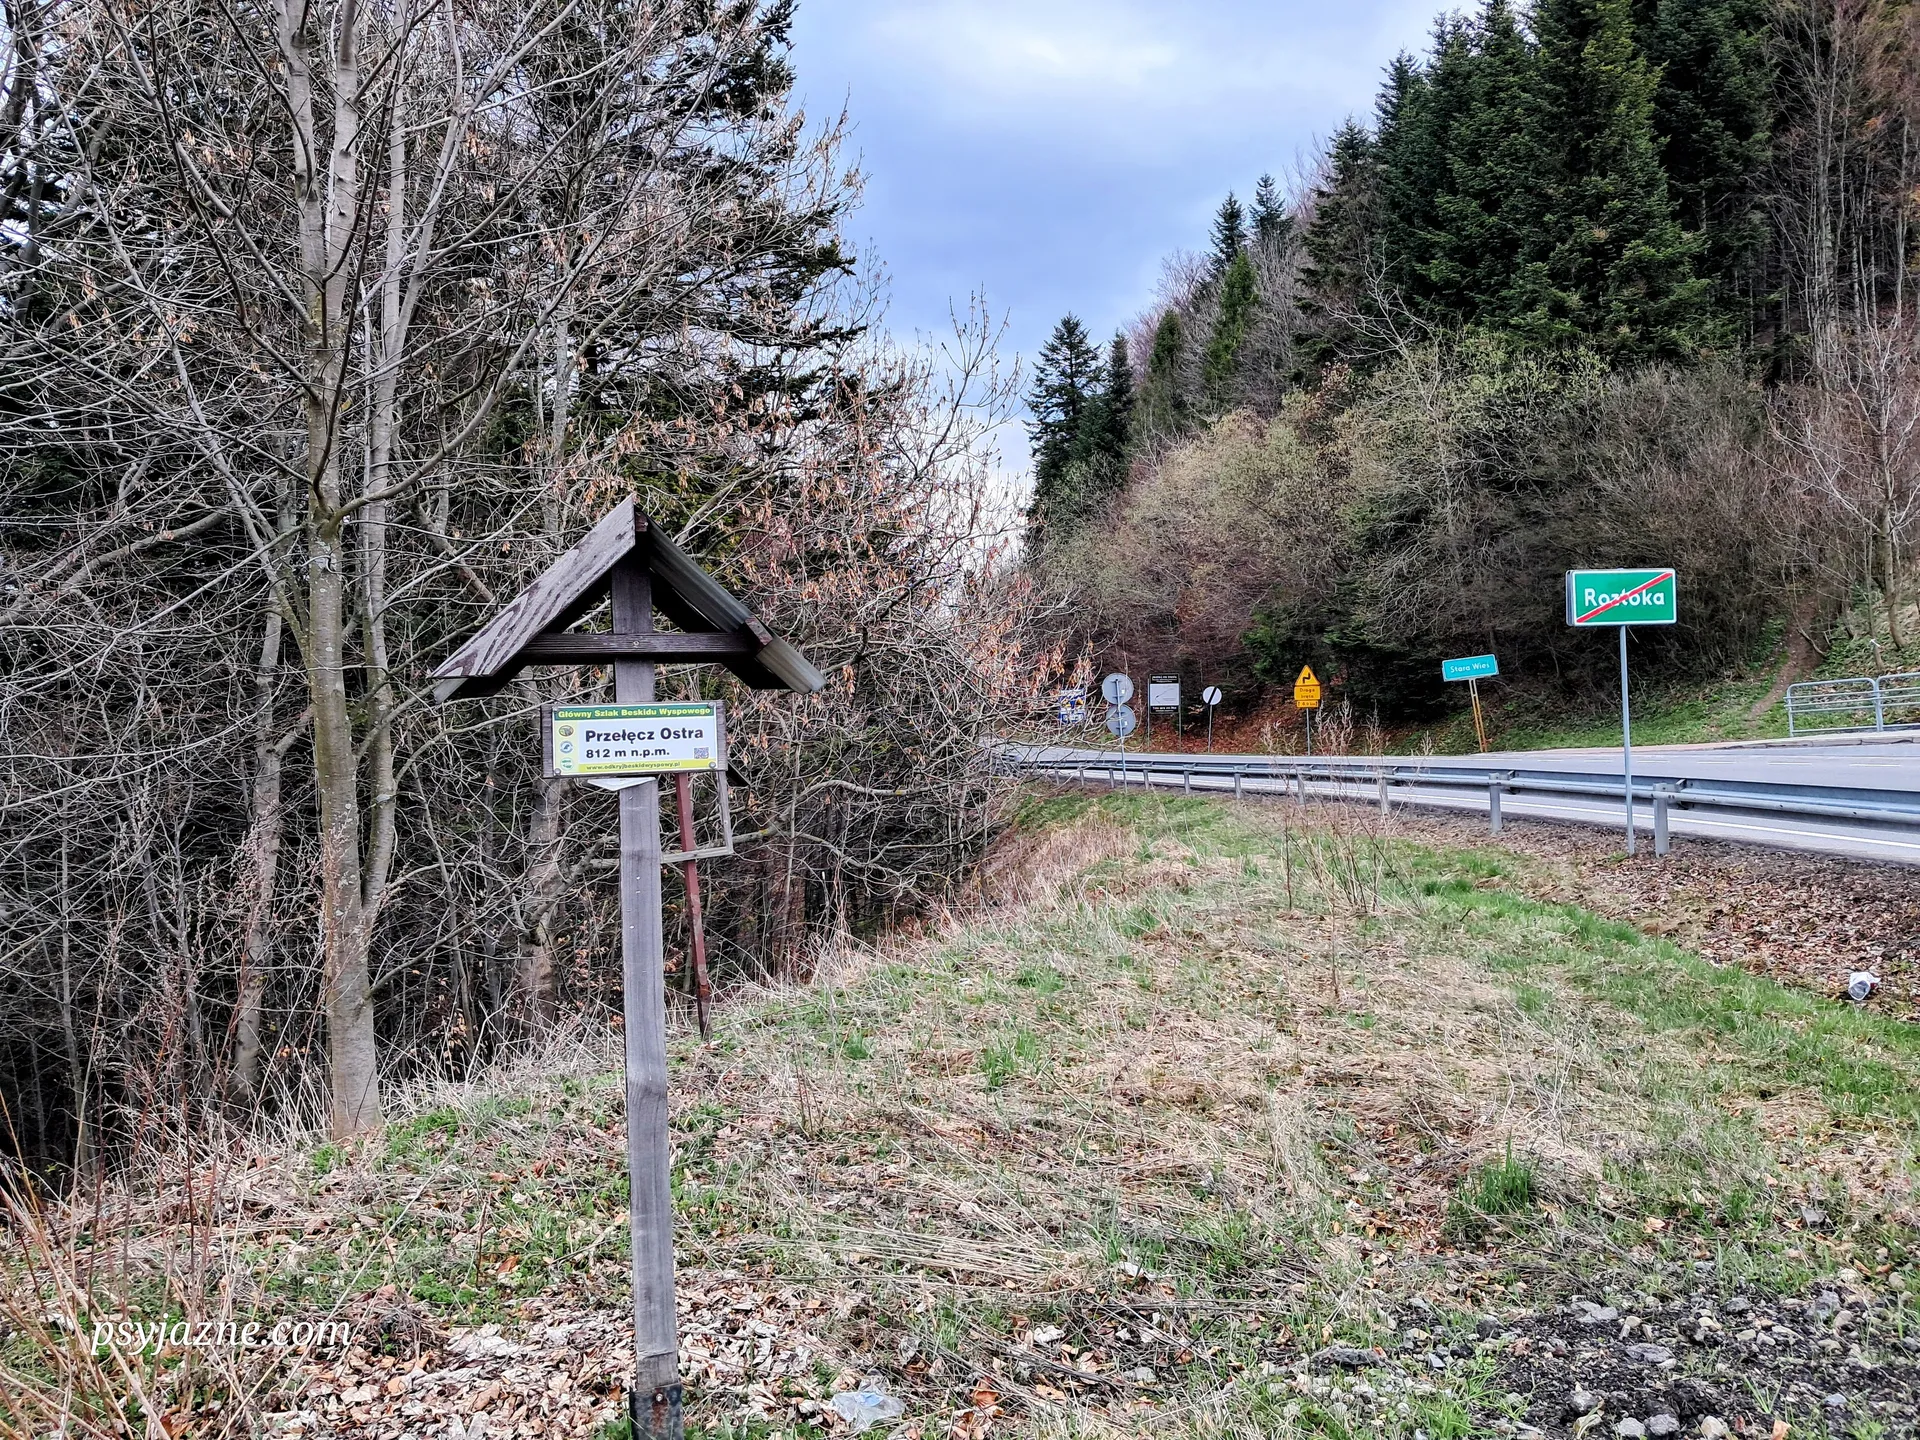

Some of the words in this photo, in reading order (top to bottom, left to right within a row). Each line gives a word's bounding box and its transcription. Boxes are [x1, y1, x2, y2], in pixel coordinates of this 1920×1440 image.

[1584, 588, 1665, 606] Roztoka
[1450, 665, 1470, 673] Stara
[558, 710, 592, 718] Główny
[594, 709, 618, 717] Szlak
[621, 708, 657, 716] Beskidu
[659, 707, 711, 716] Wyspowego
[585, 729, 655, 744] Przełęcz
[660, 727, 704, 739] Ostra
[586, 749, 610, 758] 812
[631, 748, 670, 758] n.p.m.
